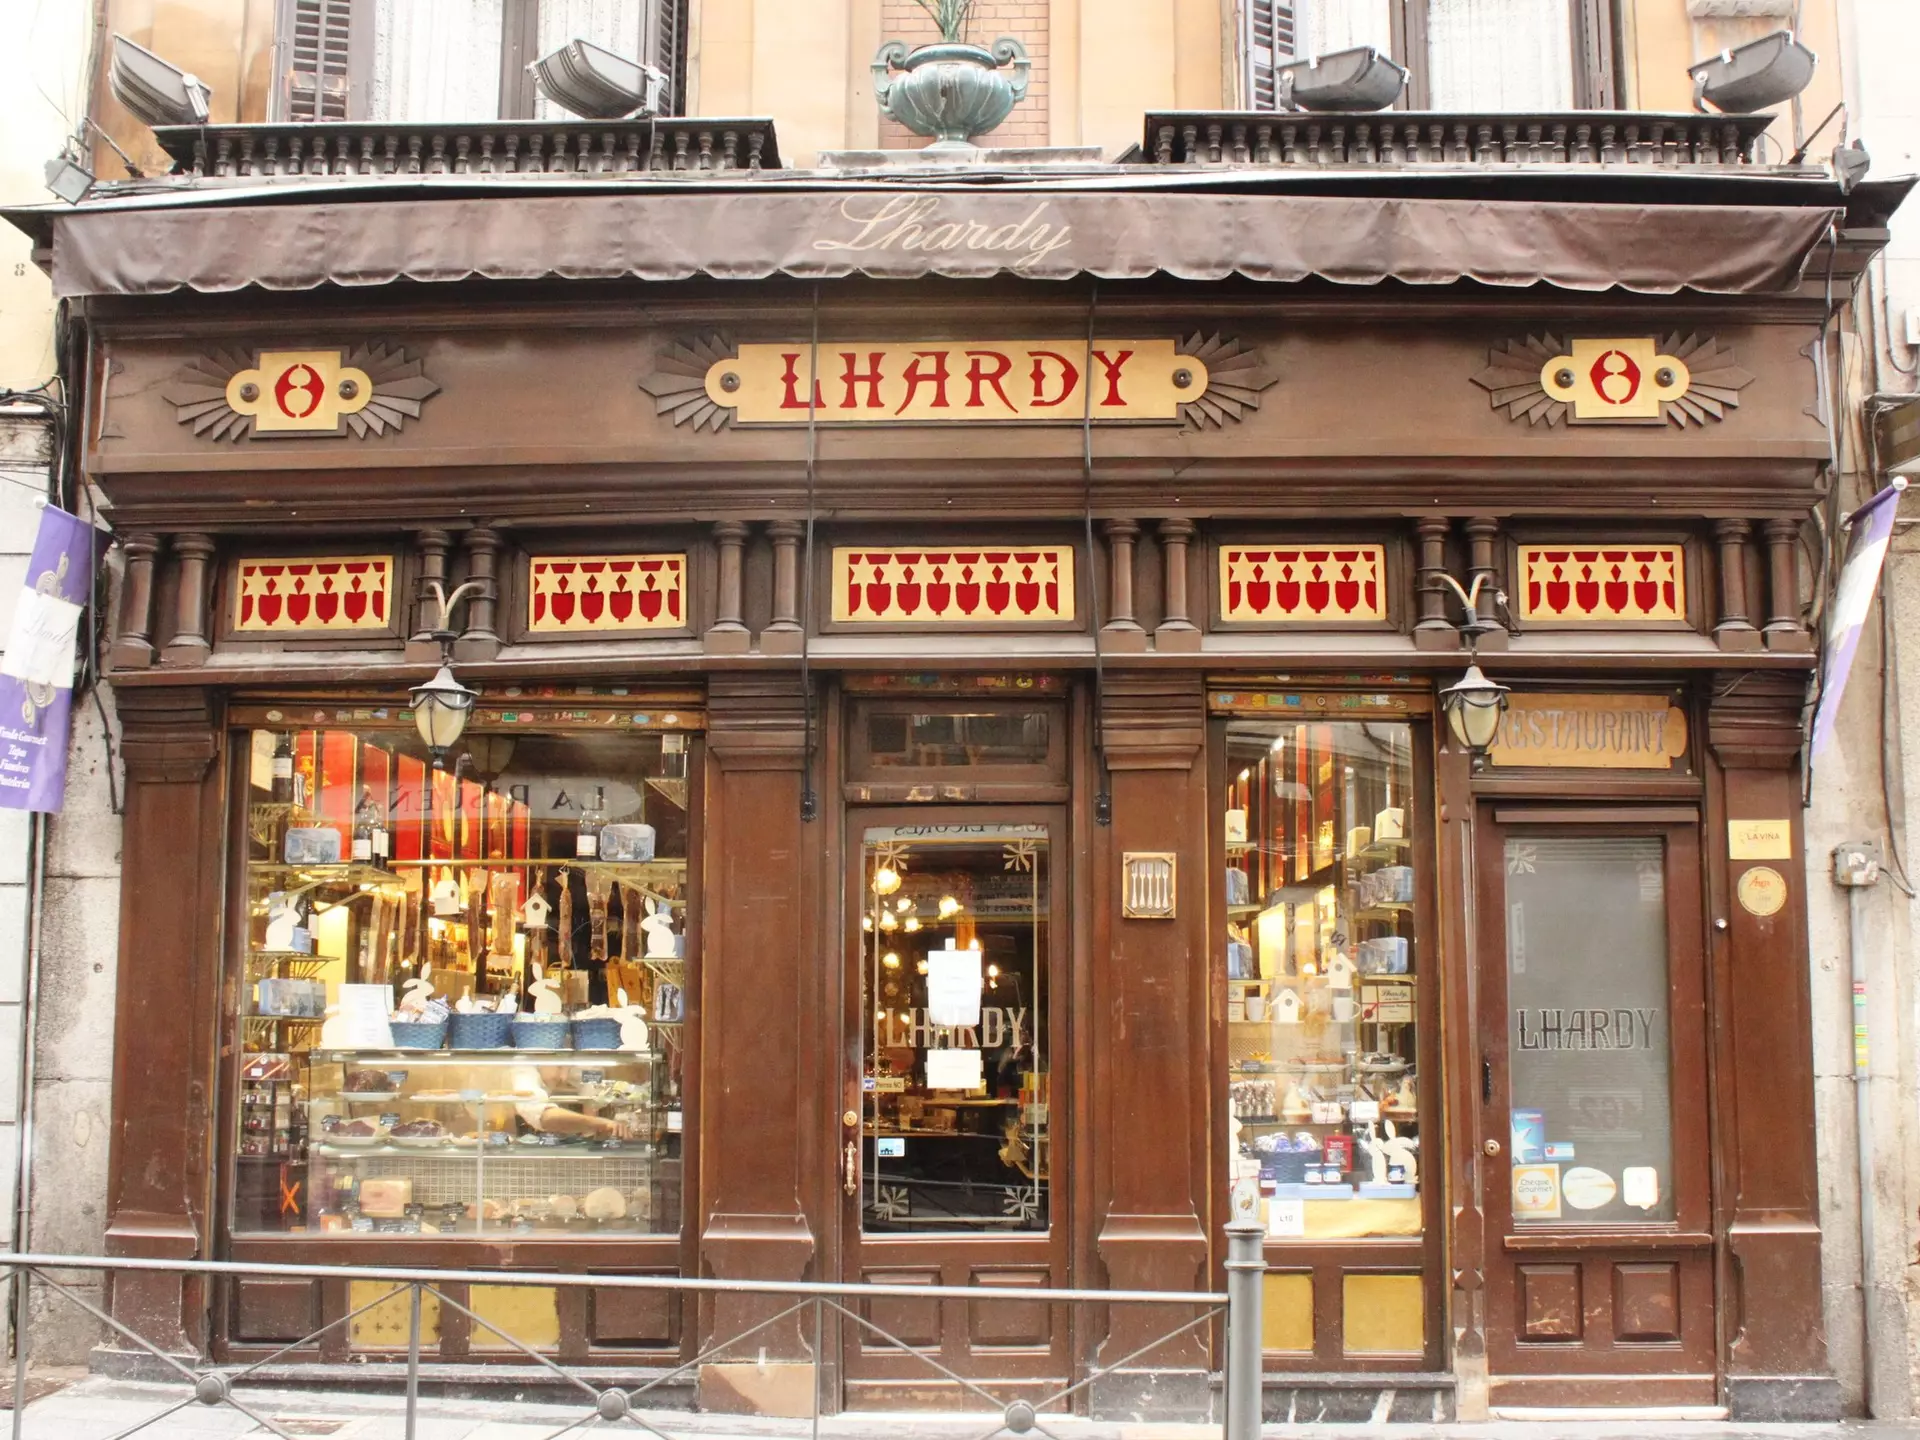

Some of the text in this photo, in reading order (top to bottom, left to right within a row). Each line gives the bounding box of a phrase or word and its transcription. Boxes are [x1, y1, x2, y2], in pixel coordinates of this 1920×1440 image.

[813, 194, 1072, 267] Lhardy
[14, 263, 26, 277] 8
[274, 363, 325, 419] 8
[780, 349, 1135, 416] LHARDY
[1589, 349, 1642, 405] 8
[885, 1006, 1027, 1049] LHARDY
[1517, 1008, 1657, 1051] LHARDY
